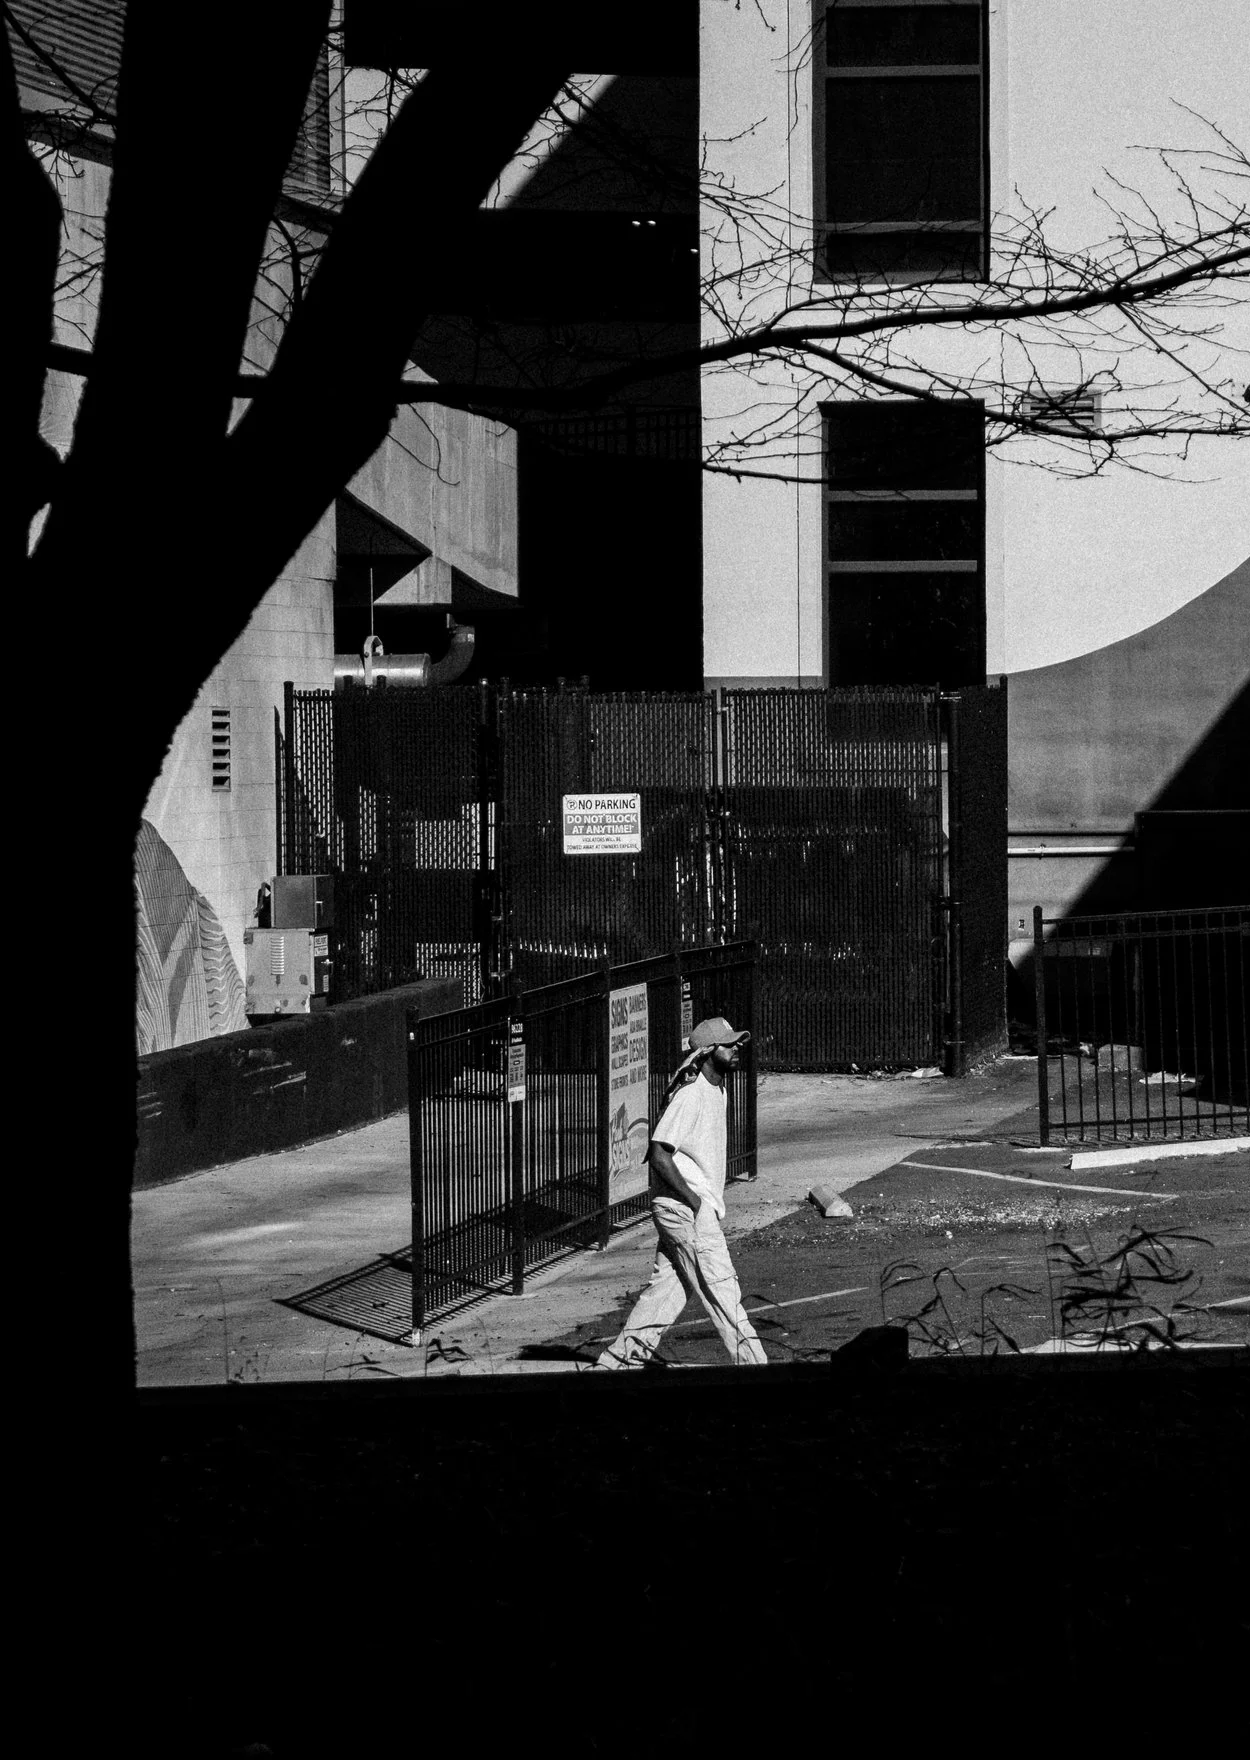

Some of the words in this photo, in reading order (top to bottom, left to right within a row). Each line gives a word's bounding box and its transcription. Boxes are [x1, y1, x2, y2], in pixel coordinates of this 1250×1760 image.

[578, 799, 593, 810] NO
[595, 798, 636, 810] PARKING
[566, 814, 582, 824] DO
[584, 814, 604, 824] NOT
[605, 813, 638, 823] BLOCK
[572, 825, 585, 835] AT
